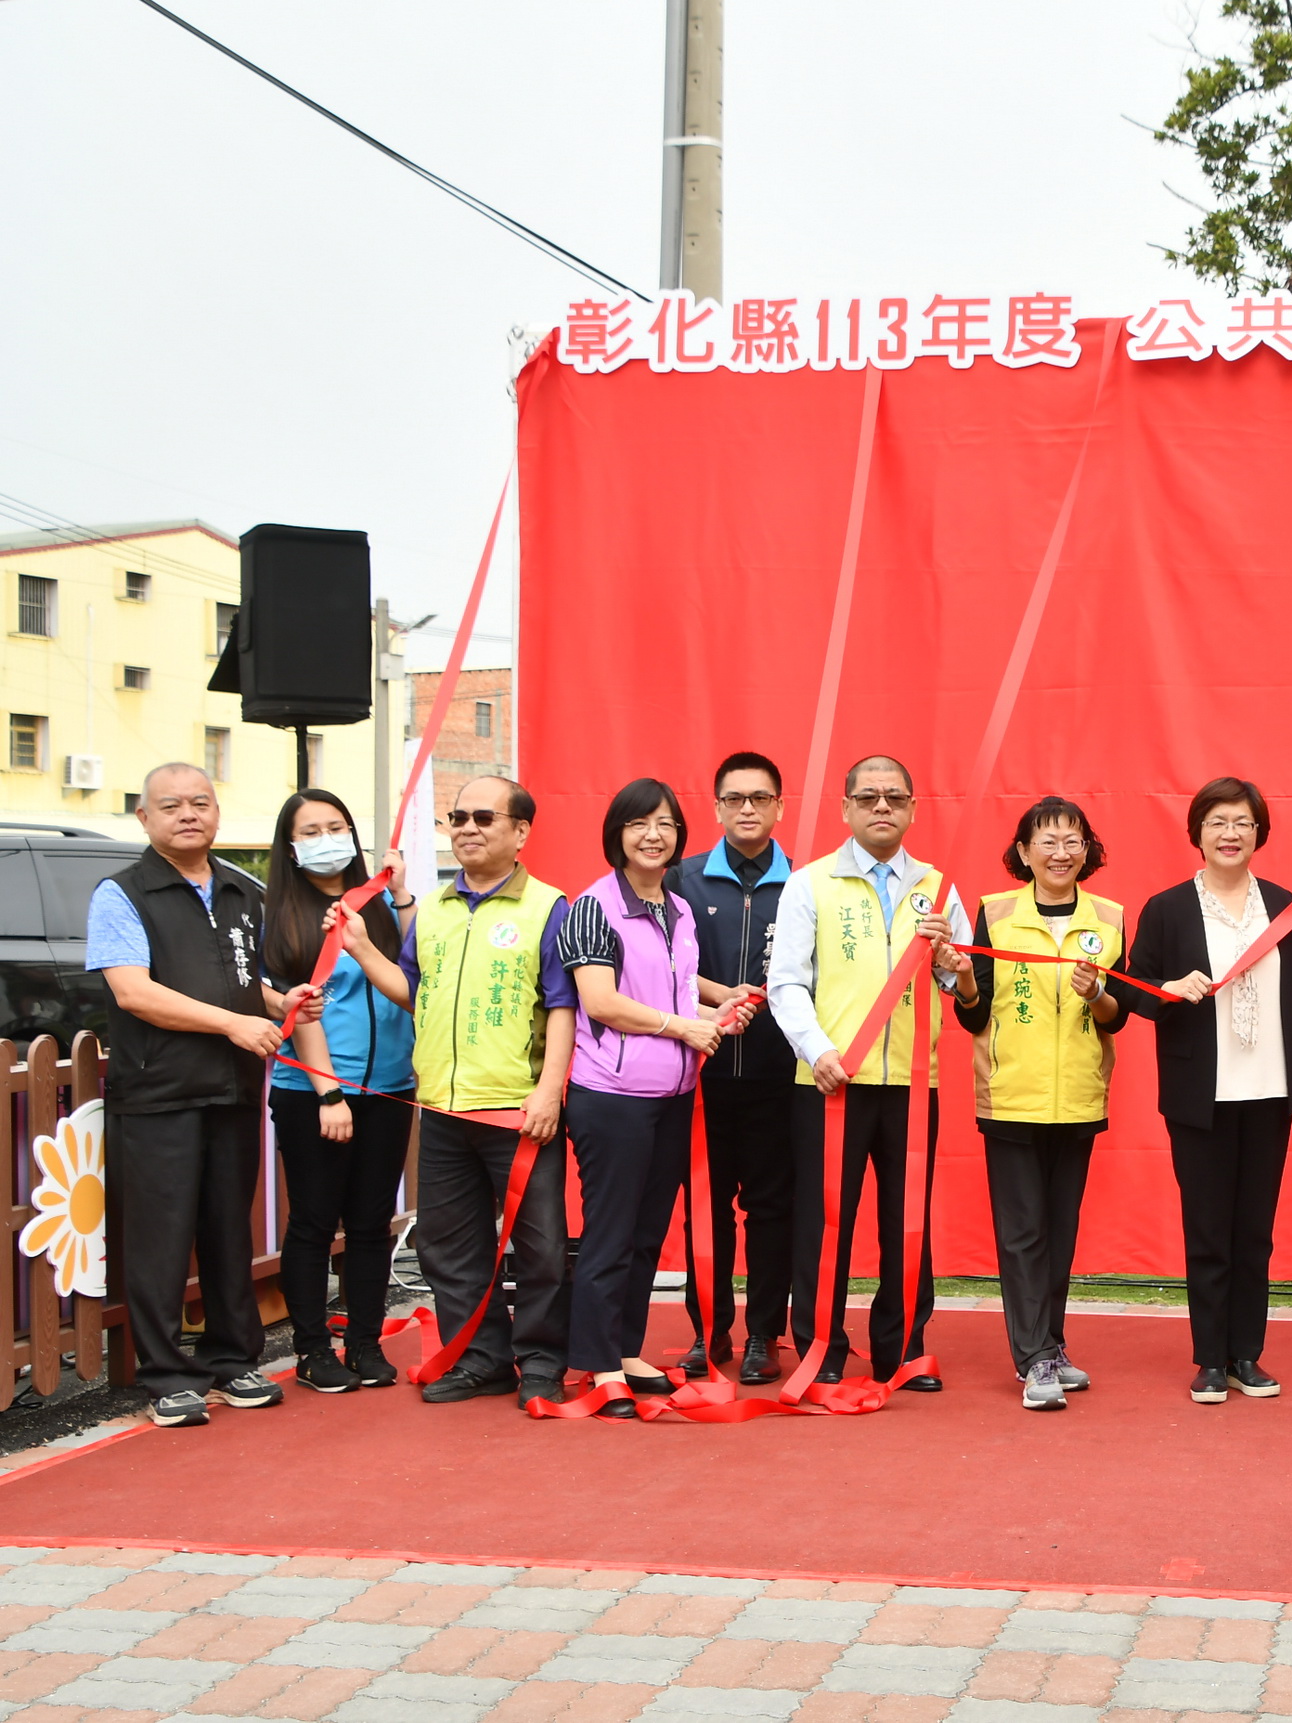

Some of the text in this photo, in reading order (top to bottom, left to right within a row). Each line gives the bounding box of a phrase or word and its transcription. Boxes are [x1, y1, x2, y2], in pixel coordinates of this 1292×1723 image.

[565, 292, 1073, 365] 彰化縣113年度
[861, 898, 873, 938] 執行長
[485, 959, 509, 1027] 許書維
